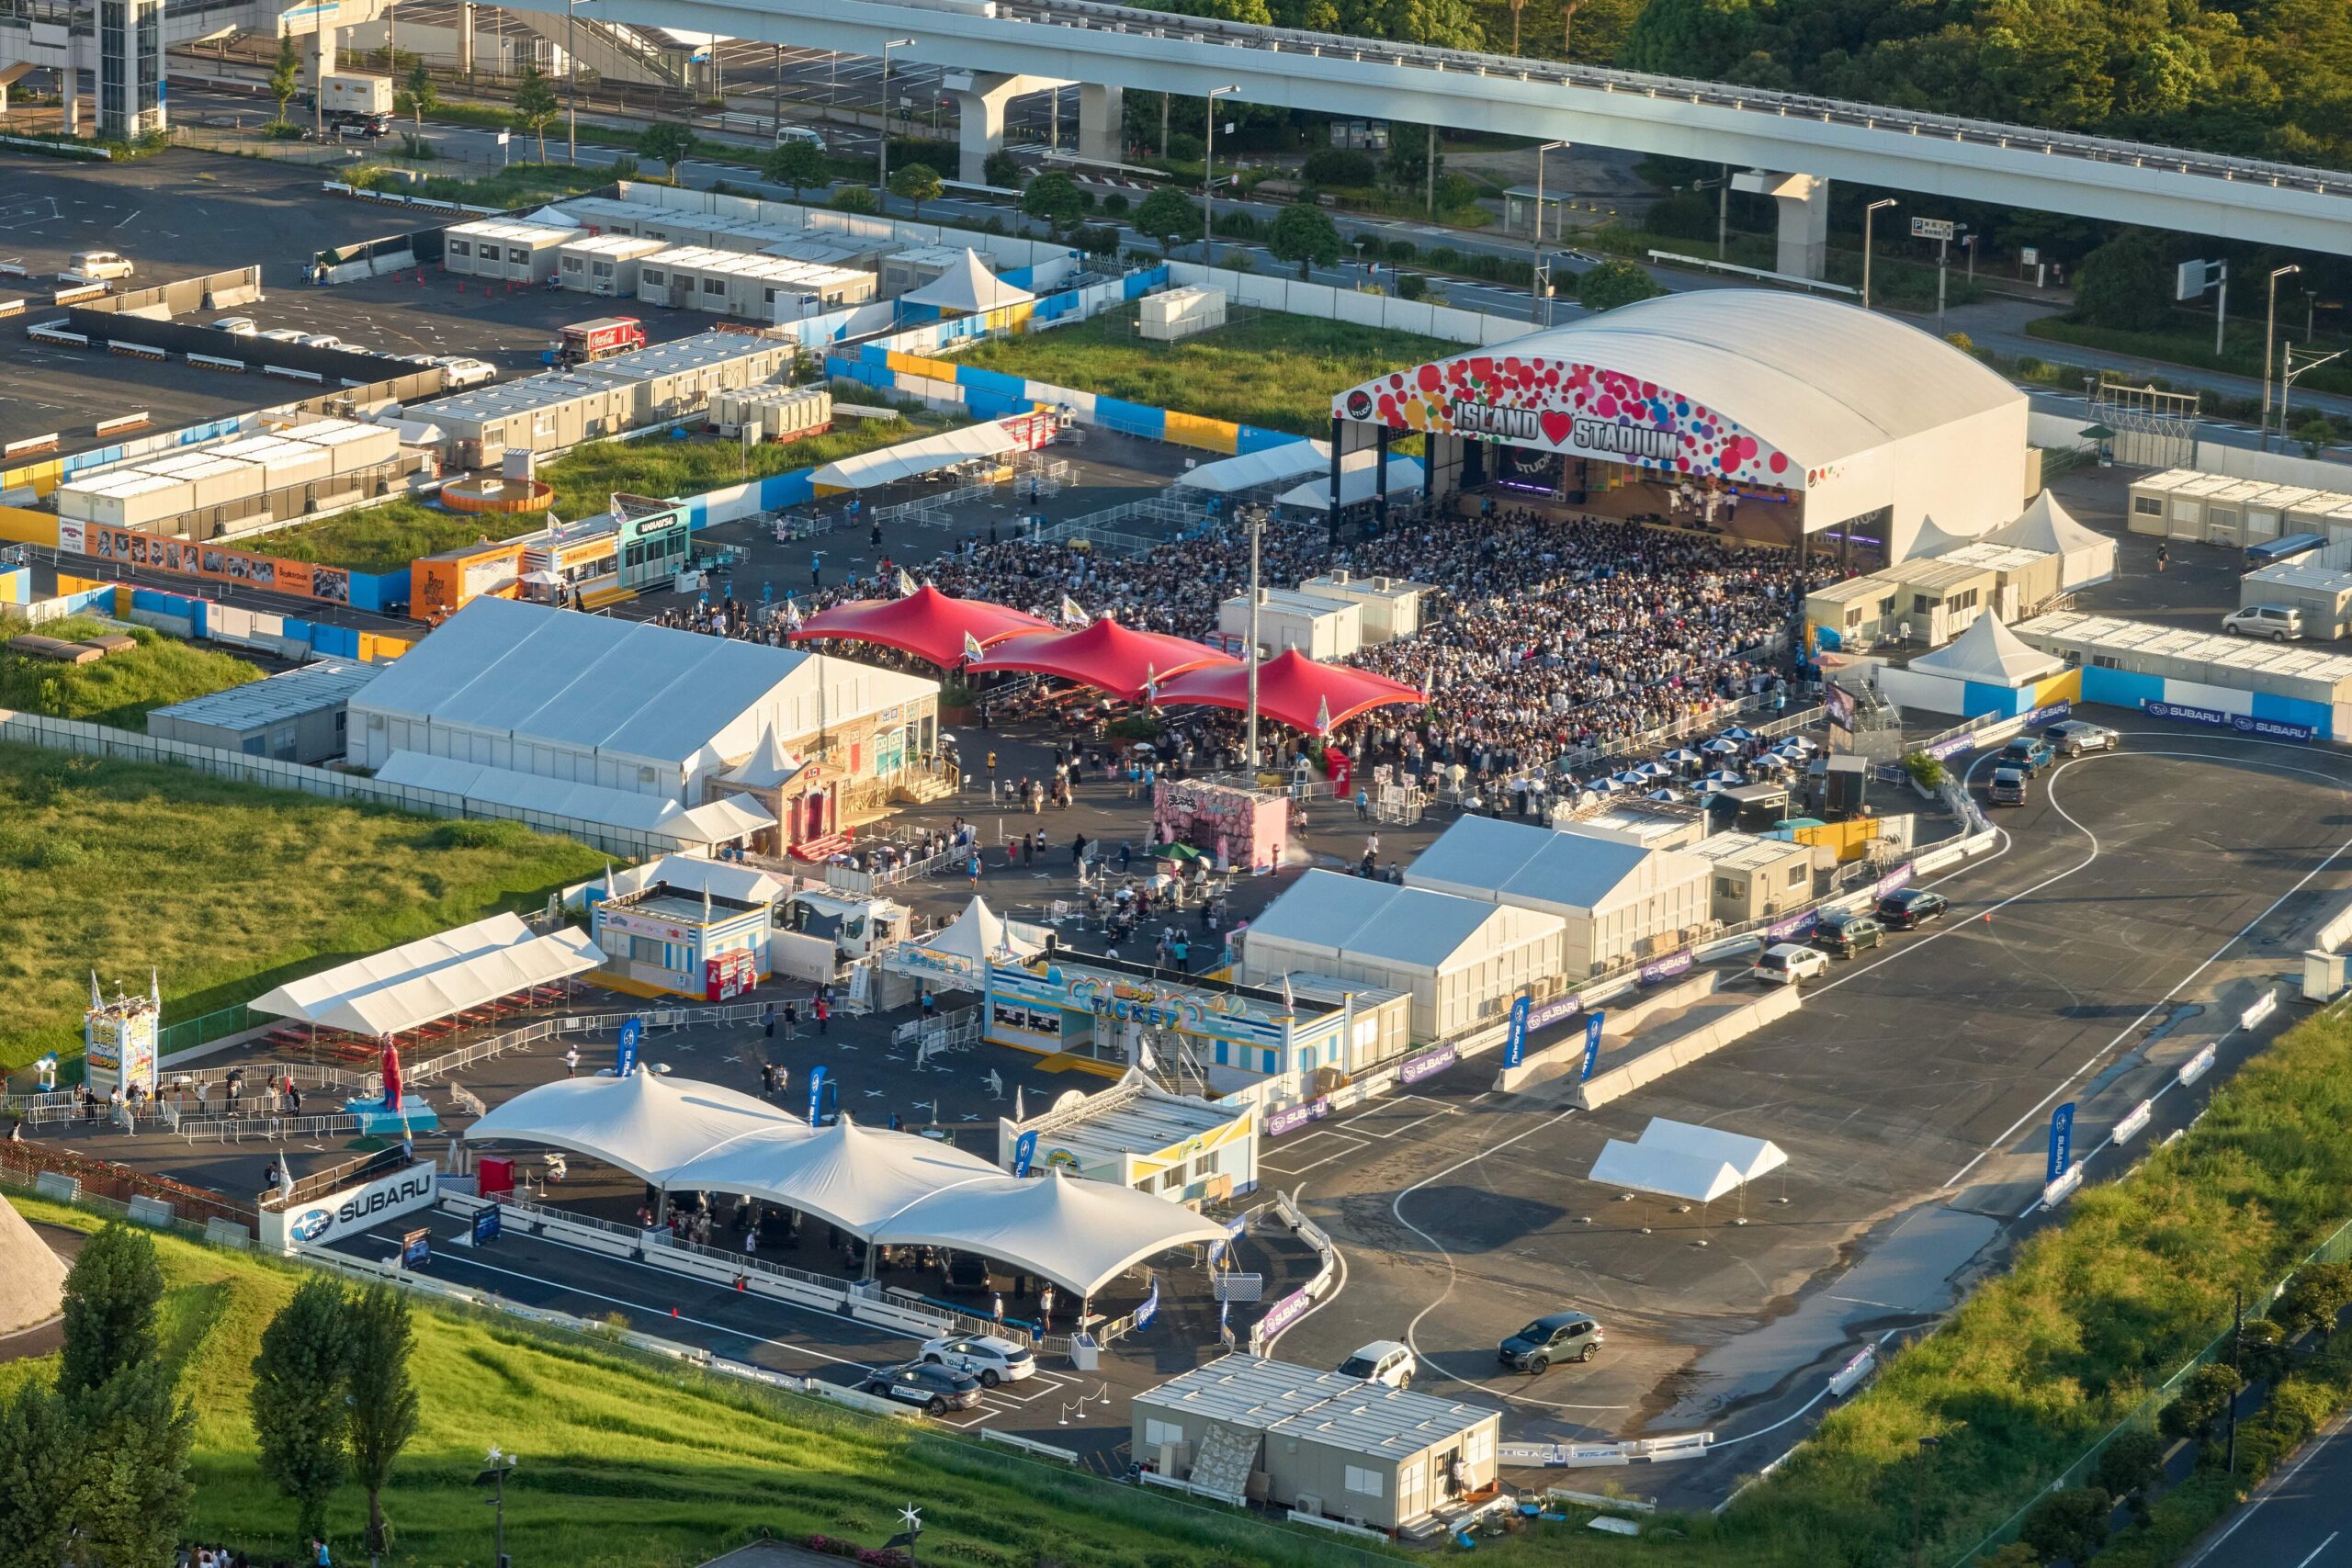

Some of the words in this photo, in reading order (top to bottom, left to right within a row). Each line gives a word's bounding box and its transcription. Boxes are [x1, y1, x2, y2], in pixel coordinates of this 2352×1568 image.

[1915, 220, 1922, 229] P
[1454, 400, 1539, 440] ISLAND
[1573, 417, 1679, 461] STADIUM
[641, 516, 673, 533] weverse
[883, 708, 898, 721] 出口
[2040, 704, 2067, 719] SUBARU
[2169, 706, 2221, 723] SUBARU
[2256, 722, 2307, 739] SUBARU
[807, 768, 818, 779] 入口
[1886, 867, 1912, 888] SUBARU
[1783, 916, 1817, 936] SUBARU
[1658, 953, 1691, 976] SUBARU
[1091, 996, 1179, 1029] TICKET
[1542, 1000, 1578, 1021] SUBARU
[1511, 1025, 1521, 1064] SUBARU
[1416, 1050, 1453, 1074] SUBARU
[1286, 1099, 1325, 1125] SUBARU
[2054, 1135, 2064, 1175] SUBARU
[339, 1175, 431, 1224] SUBARU
[1273, 1293, 1306, 1328] SUBARU
